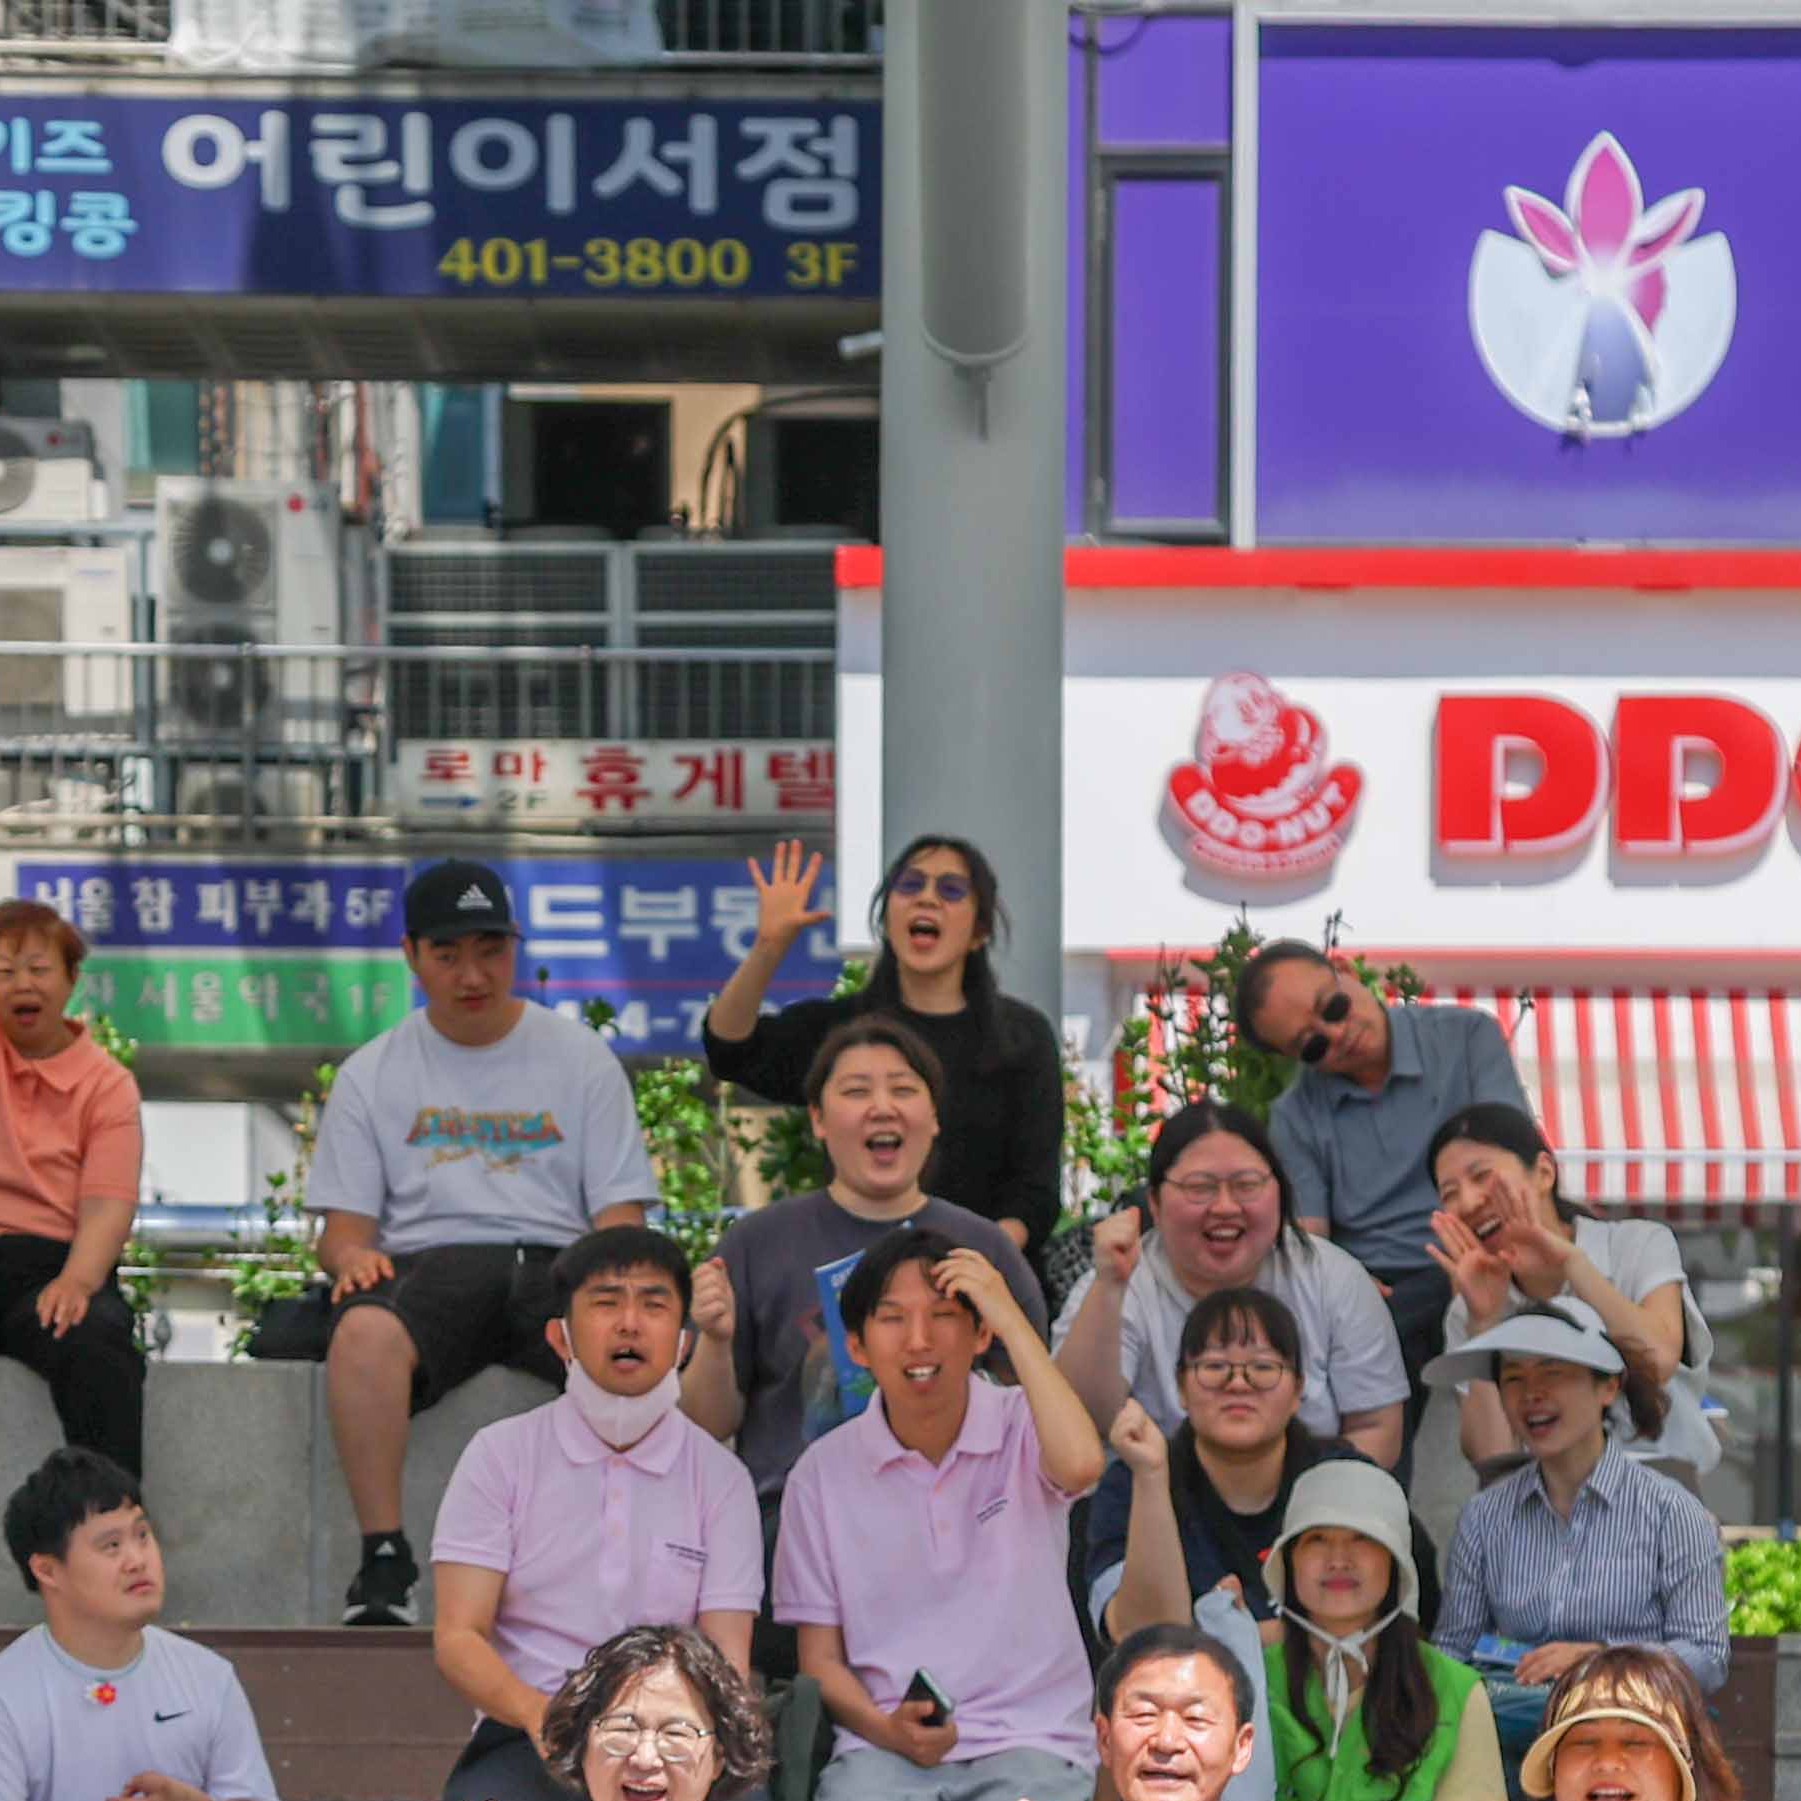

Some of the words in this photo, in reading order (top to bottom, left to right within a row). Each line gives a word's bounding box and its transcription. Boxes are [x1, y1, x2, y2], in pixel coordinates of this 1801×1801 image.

[161, 110, 861, 232] 어린이서점
[437, 237, 751, 287] 401-3800
[785, 242, 859, 287] 3F
[421, 748, 549, 784] 로마
[575, 746, 837, 813] 휴게텔
[131, 877, 177, 932] 참
[196, 878, 337, 933] 피부과
[344, 886, 396, 927] 5F
